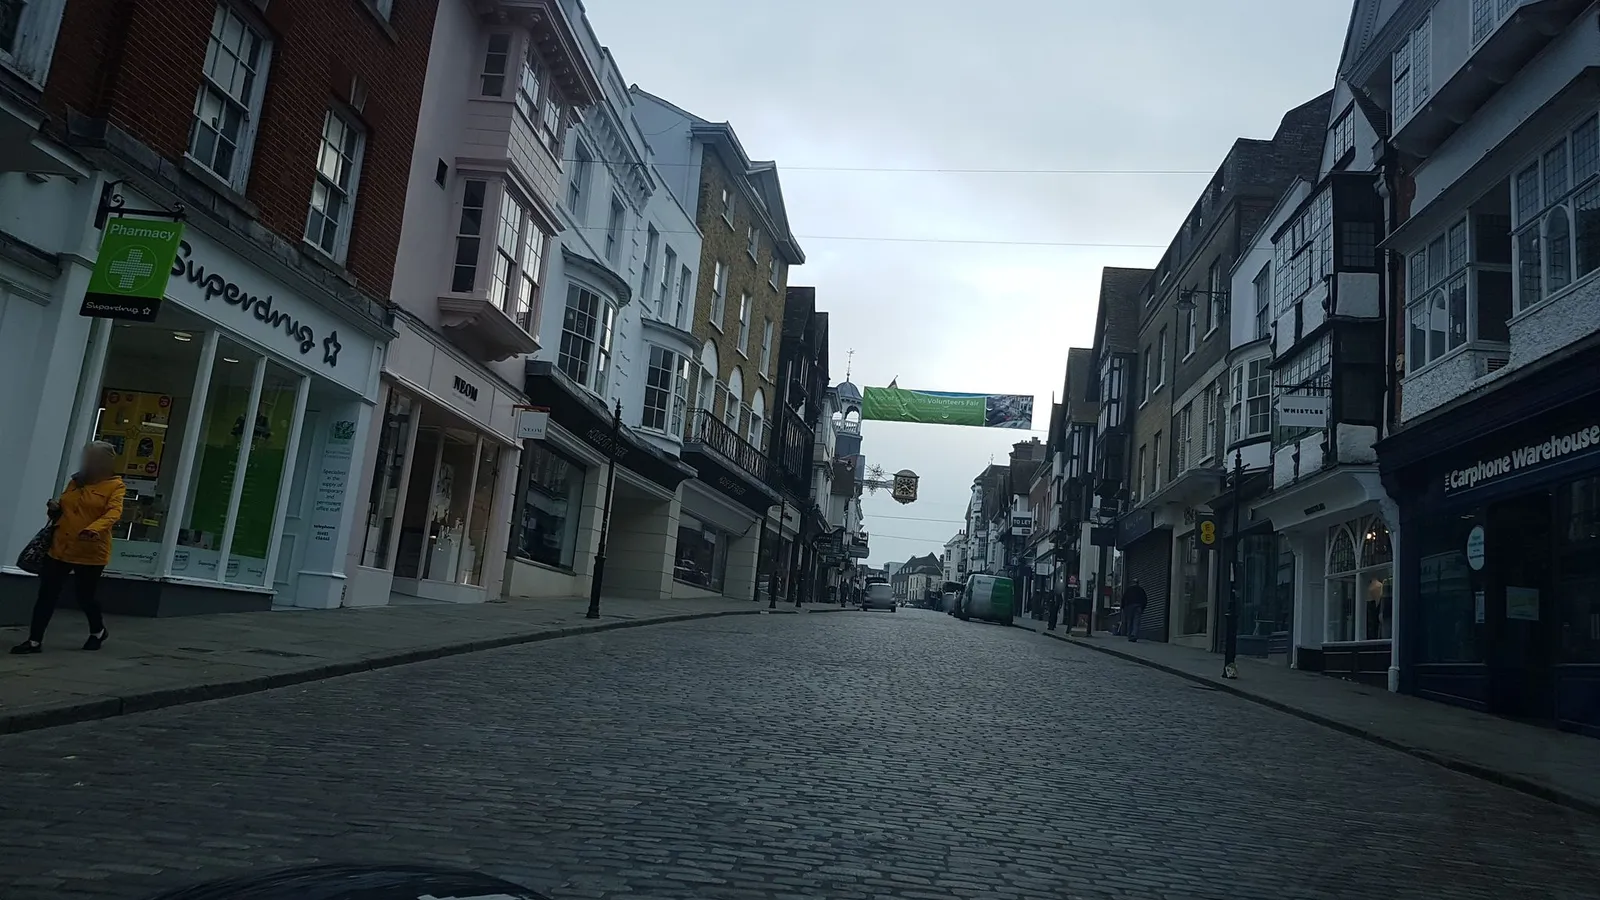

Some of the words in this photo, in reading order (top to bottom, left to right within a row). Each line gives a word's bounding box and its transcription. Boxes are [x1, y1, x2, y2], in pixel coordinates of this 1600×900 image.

[109, 223, 176, 242] Pharmacy
[85, 301, 140, 316] Superdrug
[170, 239, 316, 355] Superdrug
[453, 375, 478, 402] NEON
[927, 398, 965, 406] Volunteers
[1450, 455, 1511, 488] Carphone
[1511, 425, 1600, 469] Warehouse
